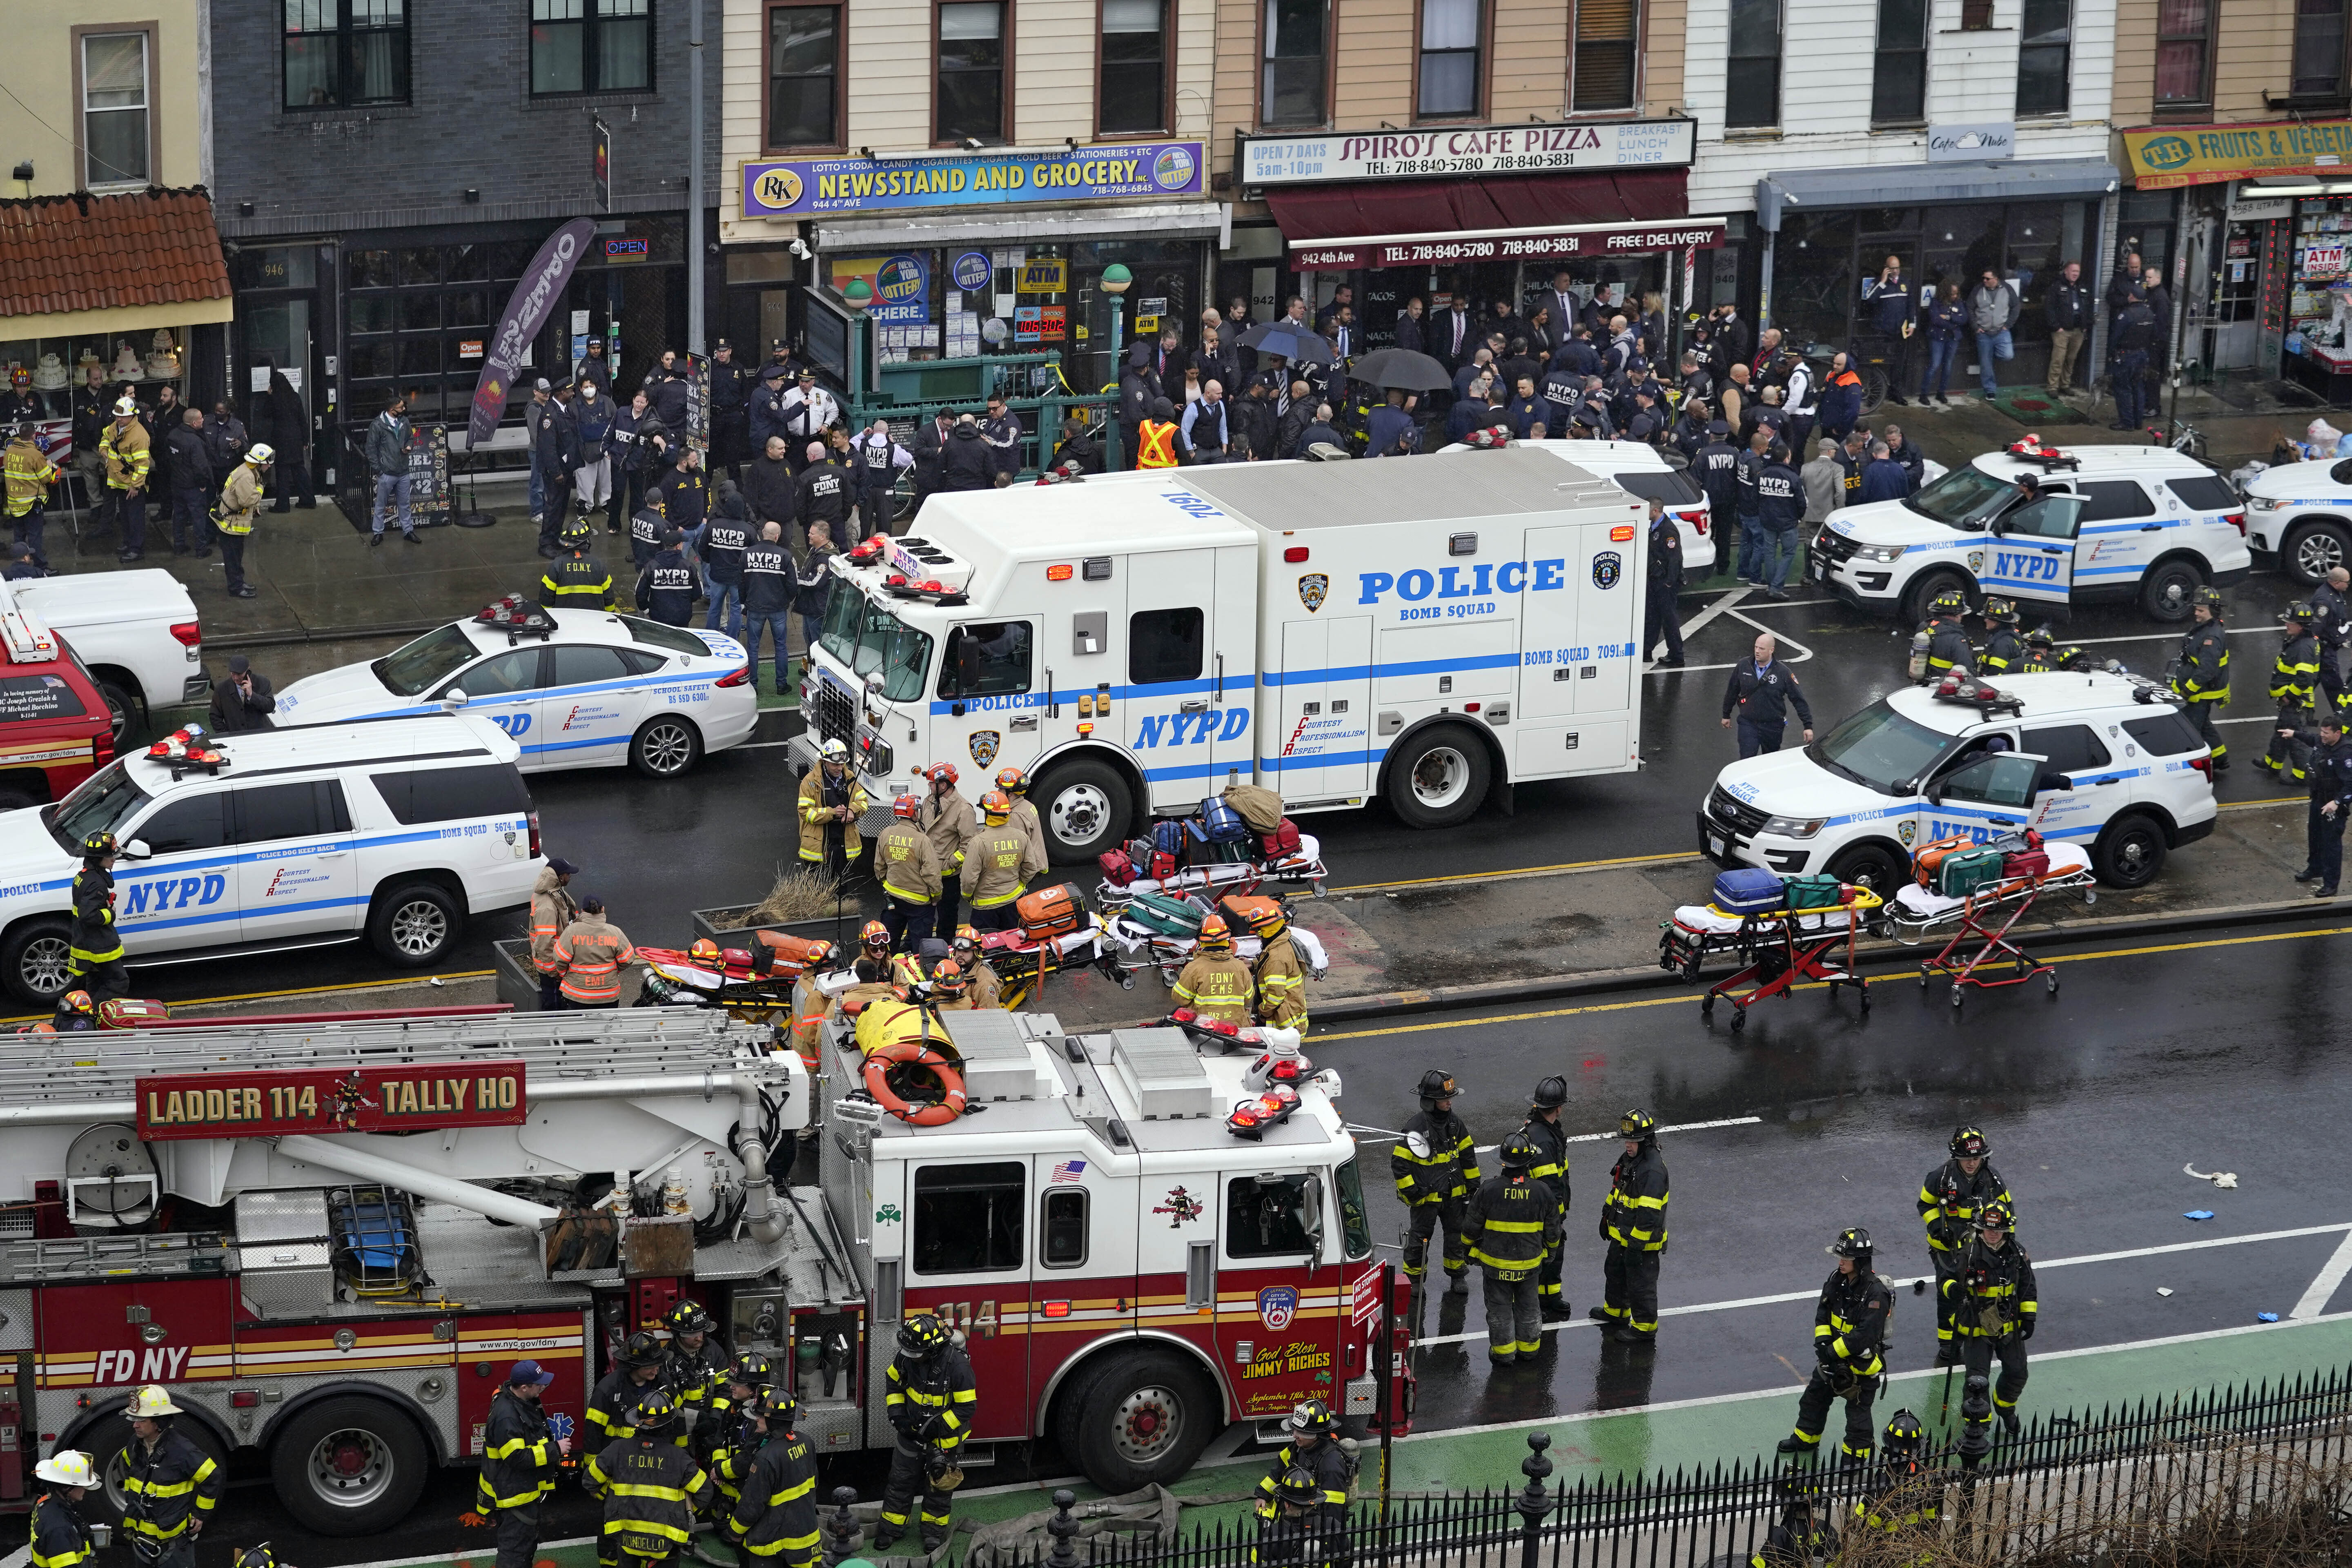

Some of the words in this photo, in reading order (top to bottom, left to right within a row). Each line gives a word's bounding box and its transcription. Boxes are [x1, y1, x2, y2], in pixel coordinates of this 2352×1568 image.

[1619, 125, 1682, 136] BREAKFAST
[1339, 134, 1439, 161] SPIRO'S
[1448, 131, 1512, 156] CAFE
[1525, 127, 1601, 152] PIZZA
[1619, 138, 1668, 149] LUNCH
[1980, 133, 2007, 147] Nube
[2198, 132, 2264, 158] FRUITS
[2270, 131, 2284, 155] &
[1253, 145, 1283, 160] OPEN
[1287, 145, 1293, 158] 7
[1297, 144, 1326, 157] DAYS
[1618, 152, 1662, 163] DINER
[812, 164, 840, 172] LOTTO
[849, 162, 873, 170] SODA
[882, 160, 913, 169] CANDY
[922, 156, 973, 167] CIGARETTES
[1042, 152, 1062, 161] BEER
[1071, 149, 1129, 159] STATIONERIES
[1136, 148, 1152, 156] ETC
[1174, 160, 1190, 169] YORK
[1366, 162, 1390, 174] TEL:
[1395, 158, 1483, 173] 718-840-5780
[1492, 153, 1574, 169] 718-840-5831
[1256, 161, 1323, 176] 5am-10pm
[819, 169, 966, 199] NEWSSTAND
[973, 166, 1025, 190] AND
[1033, 160, 1138, 188] GROCERY
[1158, 168, 1191, 184] LOTTERY
[1093, 184, 1153, 195] 718-768-6845
[844, 199, 861, 207] AVE
[608, 242, 646, 253] OPEN
[1302, 254, 1319, 265] 942
[1320, 253, 1335, 263] 4th
[1338, 252, 1354, 262] Ave
[1385, 247, 1408, 262] TEL:
[1412, 242, 1494, 260] 718-840-5780
[1502, 237, 1579, 255] 718-840-5831
[1607, 235, 1643, 248] FREE
[1647, 231, 1714, 246] DELIVERY
[2308, 250, 2341, 263] ATM
[265, 264, 283, 276] 946
[898, 261, 913, 270] NEW
[2307, 263, 2340, 271] INSIDE
[900, 269, 919, 281] YORK
[1025, 267, 1060, 283] ATM
[1715, 275, 1735, 284] 940
[519, 233, 575, 331] OPEN
[881, 278, 921, 298] LOTTERY
[1252, 296, 1275, 305] 942
[879, 306, 923, 320] HERE.
[1042, 319, 1065, 331] 302
[461, 343, 481, 352] Open
[1547, 382, 1580, 398] NYPD
[1547, 391, 1579, 405] POLICE
[8, 454, 24, 463] FDNY
[865, 446, 888, 459] NYPD
[7, 463, 22, 472] EMS
[1708, 454, 1735, 470] NYPD
[813, 478, 840, 493] FDNY
[1759, 477, 1791, 490] NYPD
[1760, 486, 1791, 495] POLICE
[2303, 498, 2332, 506] POLICE
[711, 527, 746, 541] NYPD
[712, 537, 745, 547] POLICE
[1926, 540, 1956, 552] POLICE
[747, 552, 782, 564] NYPD
[747, 561, 782, 570] POLICE
[1994, 552, 2060, 581] NYPD
[654, 568, 690, 580] NYPD
[654, 577, 690, 586] POLICE
[1358, 558, 1565, 606] POLICE
[1399, 606, 1441, 621] BOMB
[1447, 601, 1496, 619] SQUAD
[1524, 650, 1552, 667] BOMB
[1556, 646, 1590, 664] SQUAD
[1597, 644, 1619, 660] 7091
[653, 685, 682, 695] SCHOOL
[683, 683, 711, 693] SAFETY
[7, 697, 27, 705] Joseph
[970, 693, 1035, 713] POLICE
[1133, 706, 1251, 751] NYPD
[1297, 717, 1343, 731] COURTESY
[1291, 728, 1367, 743] PROFESSIONALISM
[20, 749, 76, 761] www.nyc.gov/fdny
[1283, 743, 1324, 757] RESPECT
[1850, 809, 1885, 824] POLICE
[256, 851, 282, 860] POLICE
[283, 849, 297, 859] DOG
[298, 846, 318, 857] KEEP
[318, 844, 336, 855] BACK
[996, 853, 1018, 863] RESCUE
[999, 859, 1016, 868] MEDIC
[123, 873, 225, 916] NYPD
[572, 935, 619, 947] NYU-EMS
[585, 975, 606, 987] EMT
[1208, 971, 1235, 984] FDNY
[1210, 984, 1234, 995] EMS
[148, 1087, 263, 1126] LADDER
[269, 1085, 319, 1121] 114
[381, 1079, 471, 1116] TALLY
[478, 1076, 518, 1111] HO
[1967, 1140, 1980, 1149] 109
[1504, 1188, 1530, 1200] FDNY
[1354, 1283, 1361, 1294] NO
[1361, 1268, 1381, 1289] STOPPING
[1354, 1286, 1372, 1304] Anytime
[479, 1337, 558, 1350] www.nyc.gov/fdny
[1255, 1346, 1281, 1363] God
[1284, 1341, 1317, 1359] Bless
[1243, 1361, 1285, 1381] JIMMY
[1287, 1352, 1332, 1374] RICHES
[1245, 1391, 1285, 1405] September
[1306, 1388, 1331, 1400] 2001
[1295, 1410, 1307, 1422] 228
[787, 1443, 808, 1461] FDNY
[622, 1534, 667, 1551] MONDELLO
